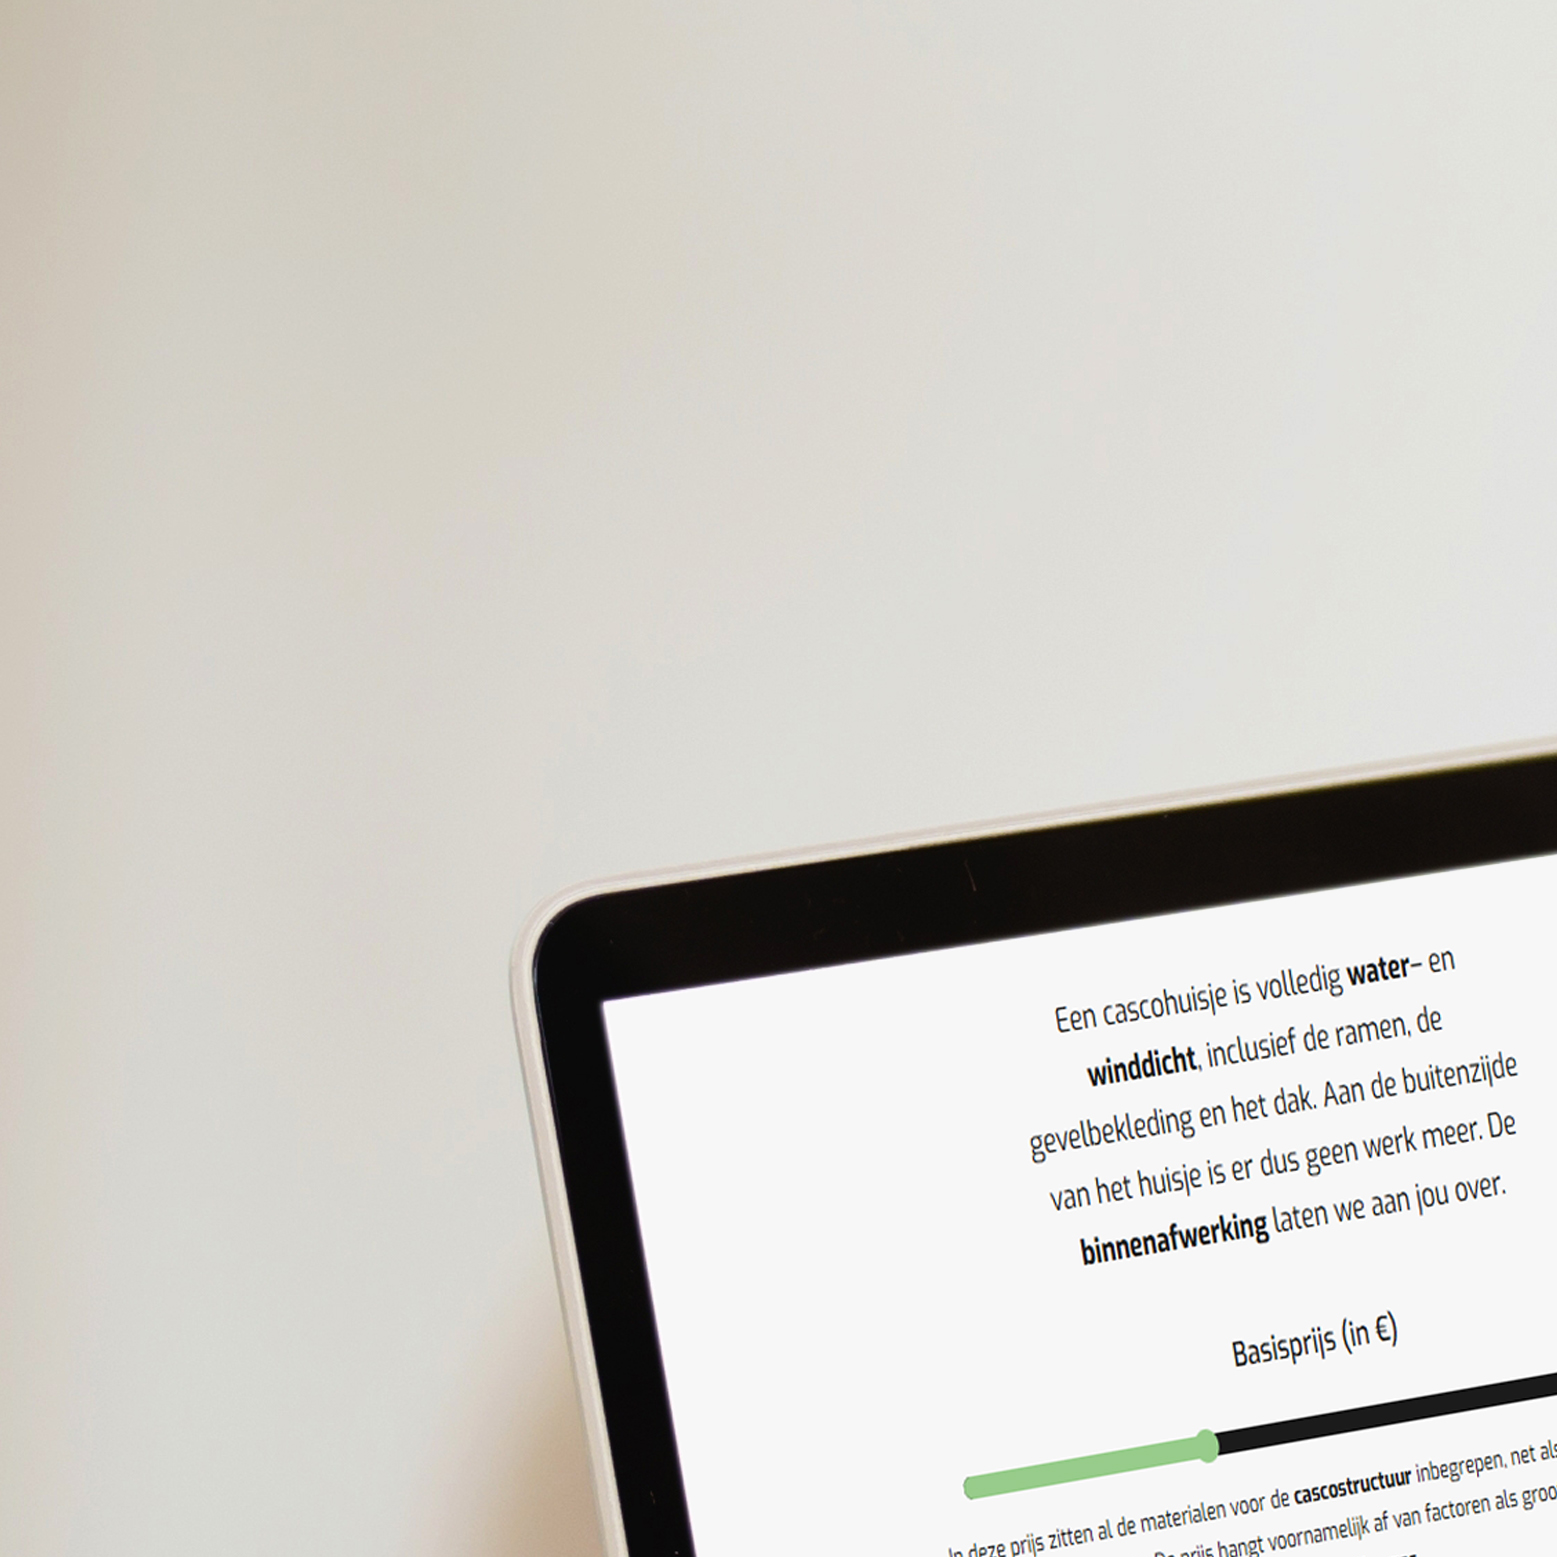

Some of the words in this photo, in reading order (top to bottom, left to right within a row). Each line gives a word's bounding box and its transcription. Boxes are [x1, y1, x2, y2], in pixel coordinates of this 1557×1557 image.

[1054, 1005, 1098, 1034] Een
[1102, 982, 1229, 1026] cascohuisje
[1231, 978, 1252, 1005] is
[1255, 963, 1345, 1001] volledig
[1427, 950, 1456, 973] en
[1085, 1045, 1203, 1088] winddicht,
[1205, 1026, 1297, 1068] inclusief
[1302, 1023, 1331, 1052] de
[1334, 1016, 1412, 1047] ramen,
[1415, 1004, 1443, 1034] de
[1029, 1107, 1196, 1164] gevelbekleding
[1198, 1104, 1227, 1128] en
[1230, 1094, 1269, 1123] het
[1272, 1084, 1318, 1116] dak.
[1323, 1080, 1366, 1108] Aan
[1370, 1070, 1398, 1100] de
[1400, 1050, 1519, 1095] buitenzijde
[1048, 1186, 1092, 1212] van
[1094, 1175, 1134, 1205] het
[1136, 1163, 1203, 1197] huisje
[1206, 1159, 1227, 1186] is
[1230, 1158, 1254, 1182] er
[1259, 1147, 1301, 1177] dus
[1304, 1141, 1359, 1177] geen
[1362, 1124, 1418, 1159] werk
[1421, 1120, 1484, 1150] meer.
[1486, 1111, 1517, 1139] De
[1079, 1212, 1271, 1266] binnenafwerking
[1271, 1204, 1329, 1233] laten
[1332, 1198, 1366, 1223] we
[1370, 1191, 1411, 1217] aan
[1414, 1183, 1450, 1217] jou
[1454, 1175, 1507, 1202] over.
[1231, 1325, 1337, 1368] Basisprijs
[1341, 1317, 1371, 1355] (in
[1374, 1310, 1398, 1348] €)
[1047, 1527, 1095, 1550] zitten
[1097, 1518, 1114, 1541] al
[1116, 1515, 1137, 1538] de
[1139, 1501, 1228, 1533] materialen
[1228, 1496, 1266, 1517] voor
[1269, 1488, 1291, 1509] de
[1293, 1470, 1412, 1505] cascostructuur
[1415, 1453, 1508, 1483] inbegrepen,
[1509, 1444, 1538, 1466] net
